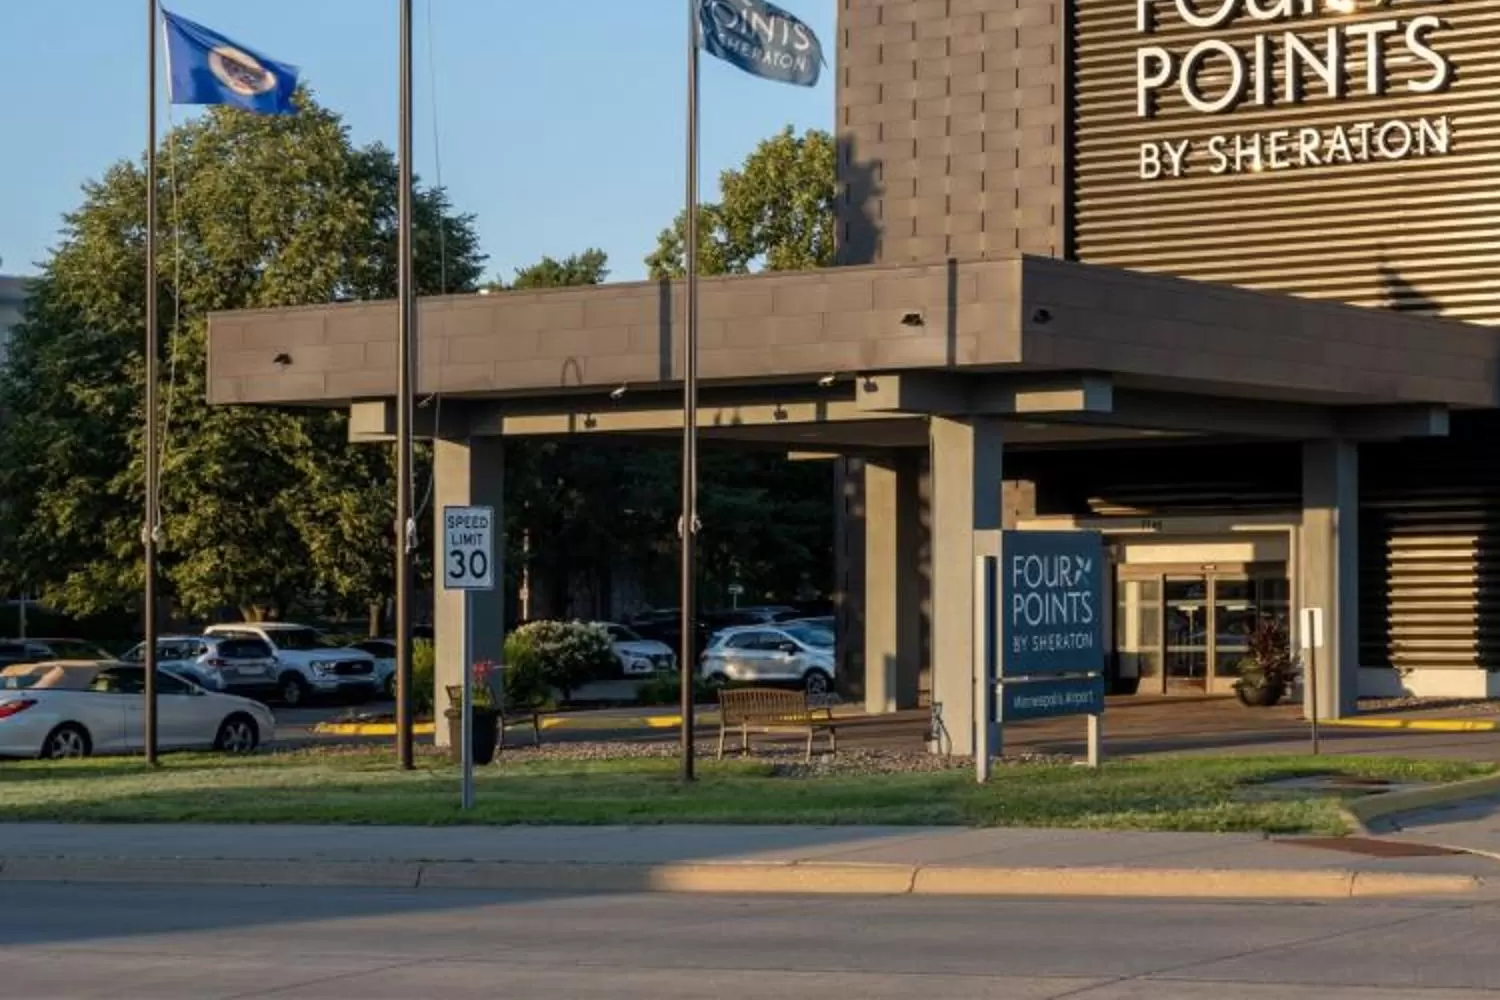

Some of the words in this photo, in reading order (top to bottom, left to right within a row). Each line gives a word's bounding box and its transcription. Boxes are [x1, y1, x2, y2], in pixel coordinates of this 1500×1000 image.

[1137, 16, 1448, 117] POINTS
[1140, 140, 1189, 180] BY
[1208, 115, 1449, 174] SHERATON
[447, 515, 489, 529] SPEED
[451, 533, 483, 546] LIMIT
[449, 549, 488, 579] 30
[1013, 554, 1073, 589] FOUR
[1013, 591, 1094, 627] POINTS
[1013, 635, 1028, 653] BY
[1031, 631, 1093, 652] SHERATON
